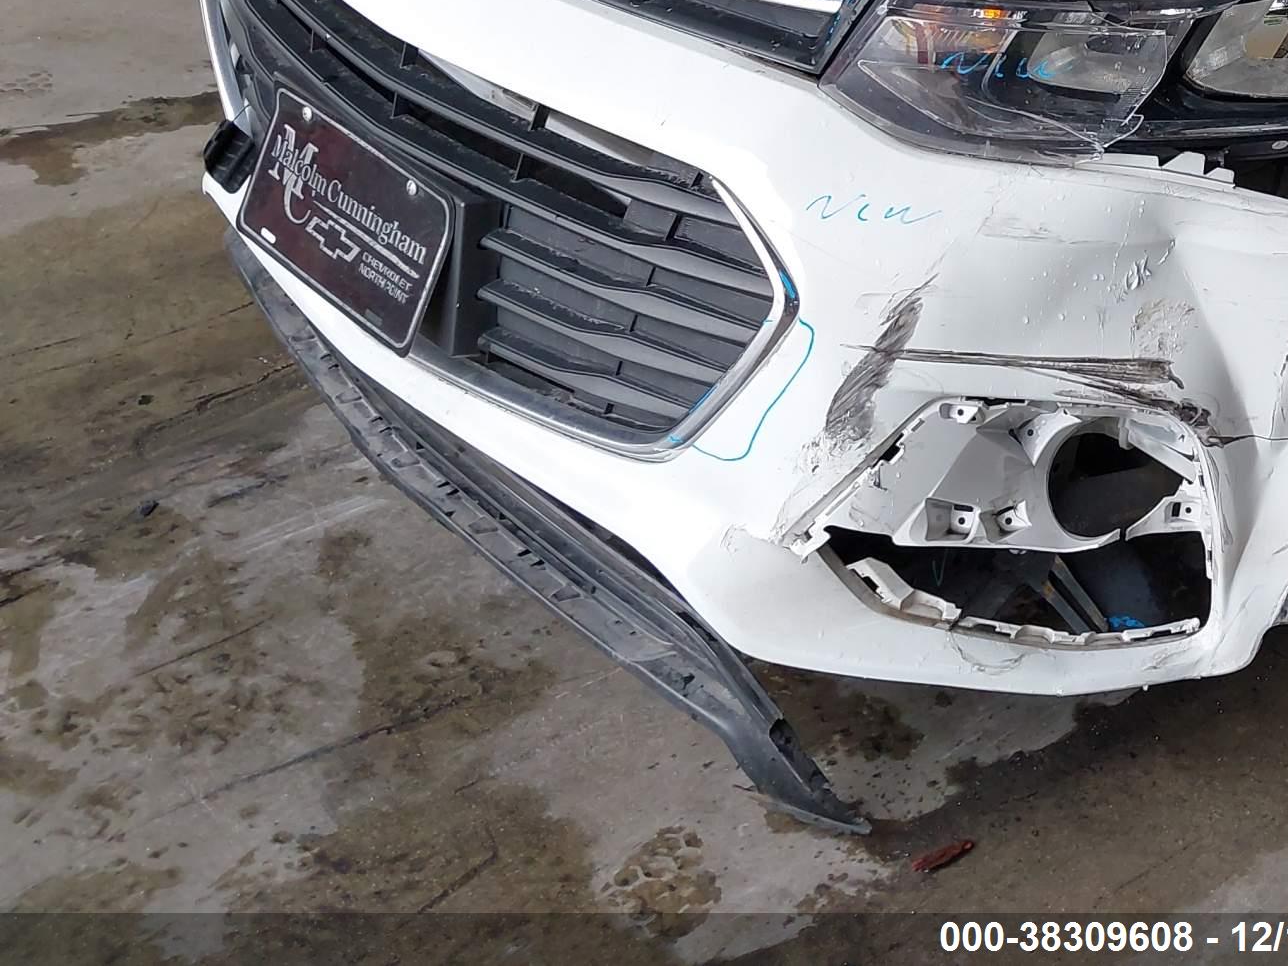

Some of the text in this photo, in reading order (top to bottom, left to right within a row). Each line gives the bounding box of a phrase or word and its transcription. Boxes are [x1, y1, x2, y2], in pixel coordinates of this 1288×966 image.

[270, 134, 427, 266] Malcolm Cunningham
[362, 251, 413, 291] CHEVROLET
